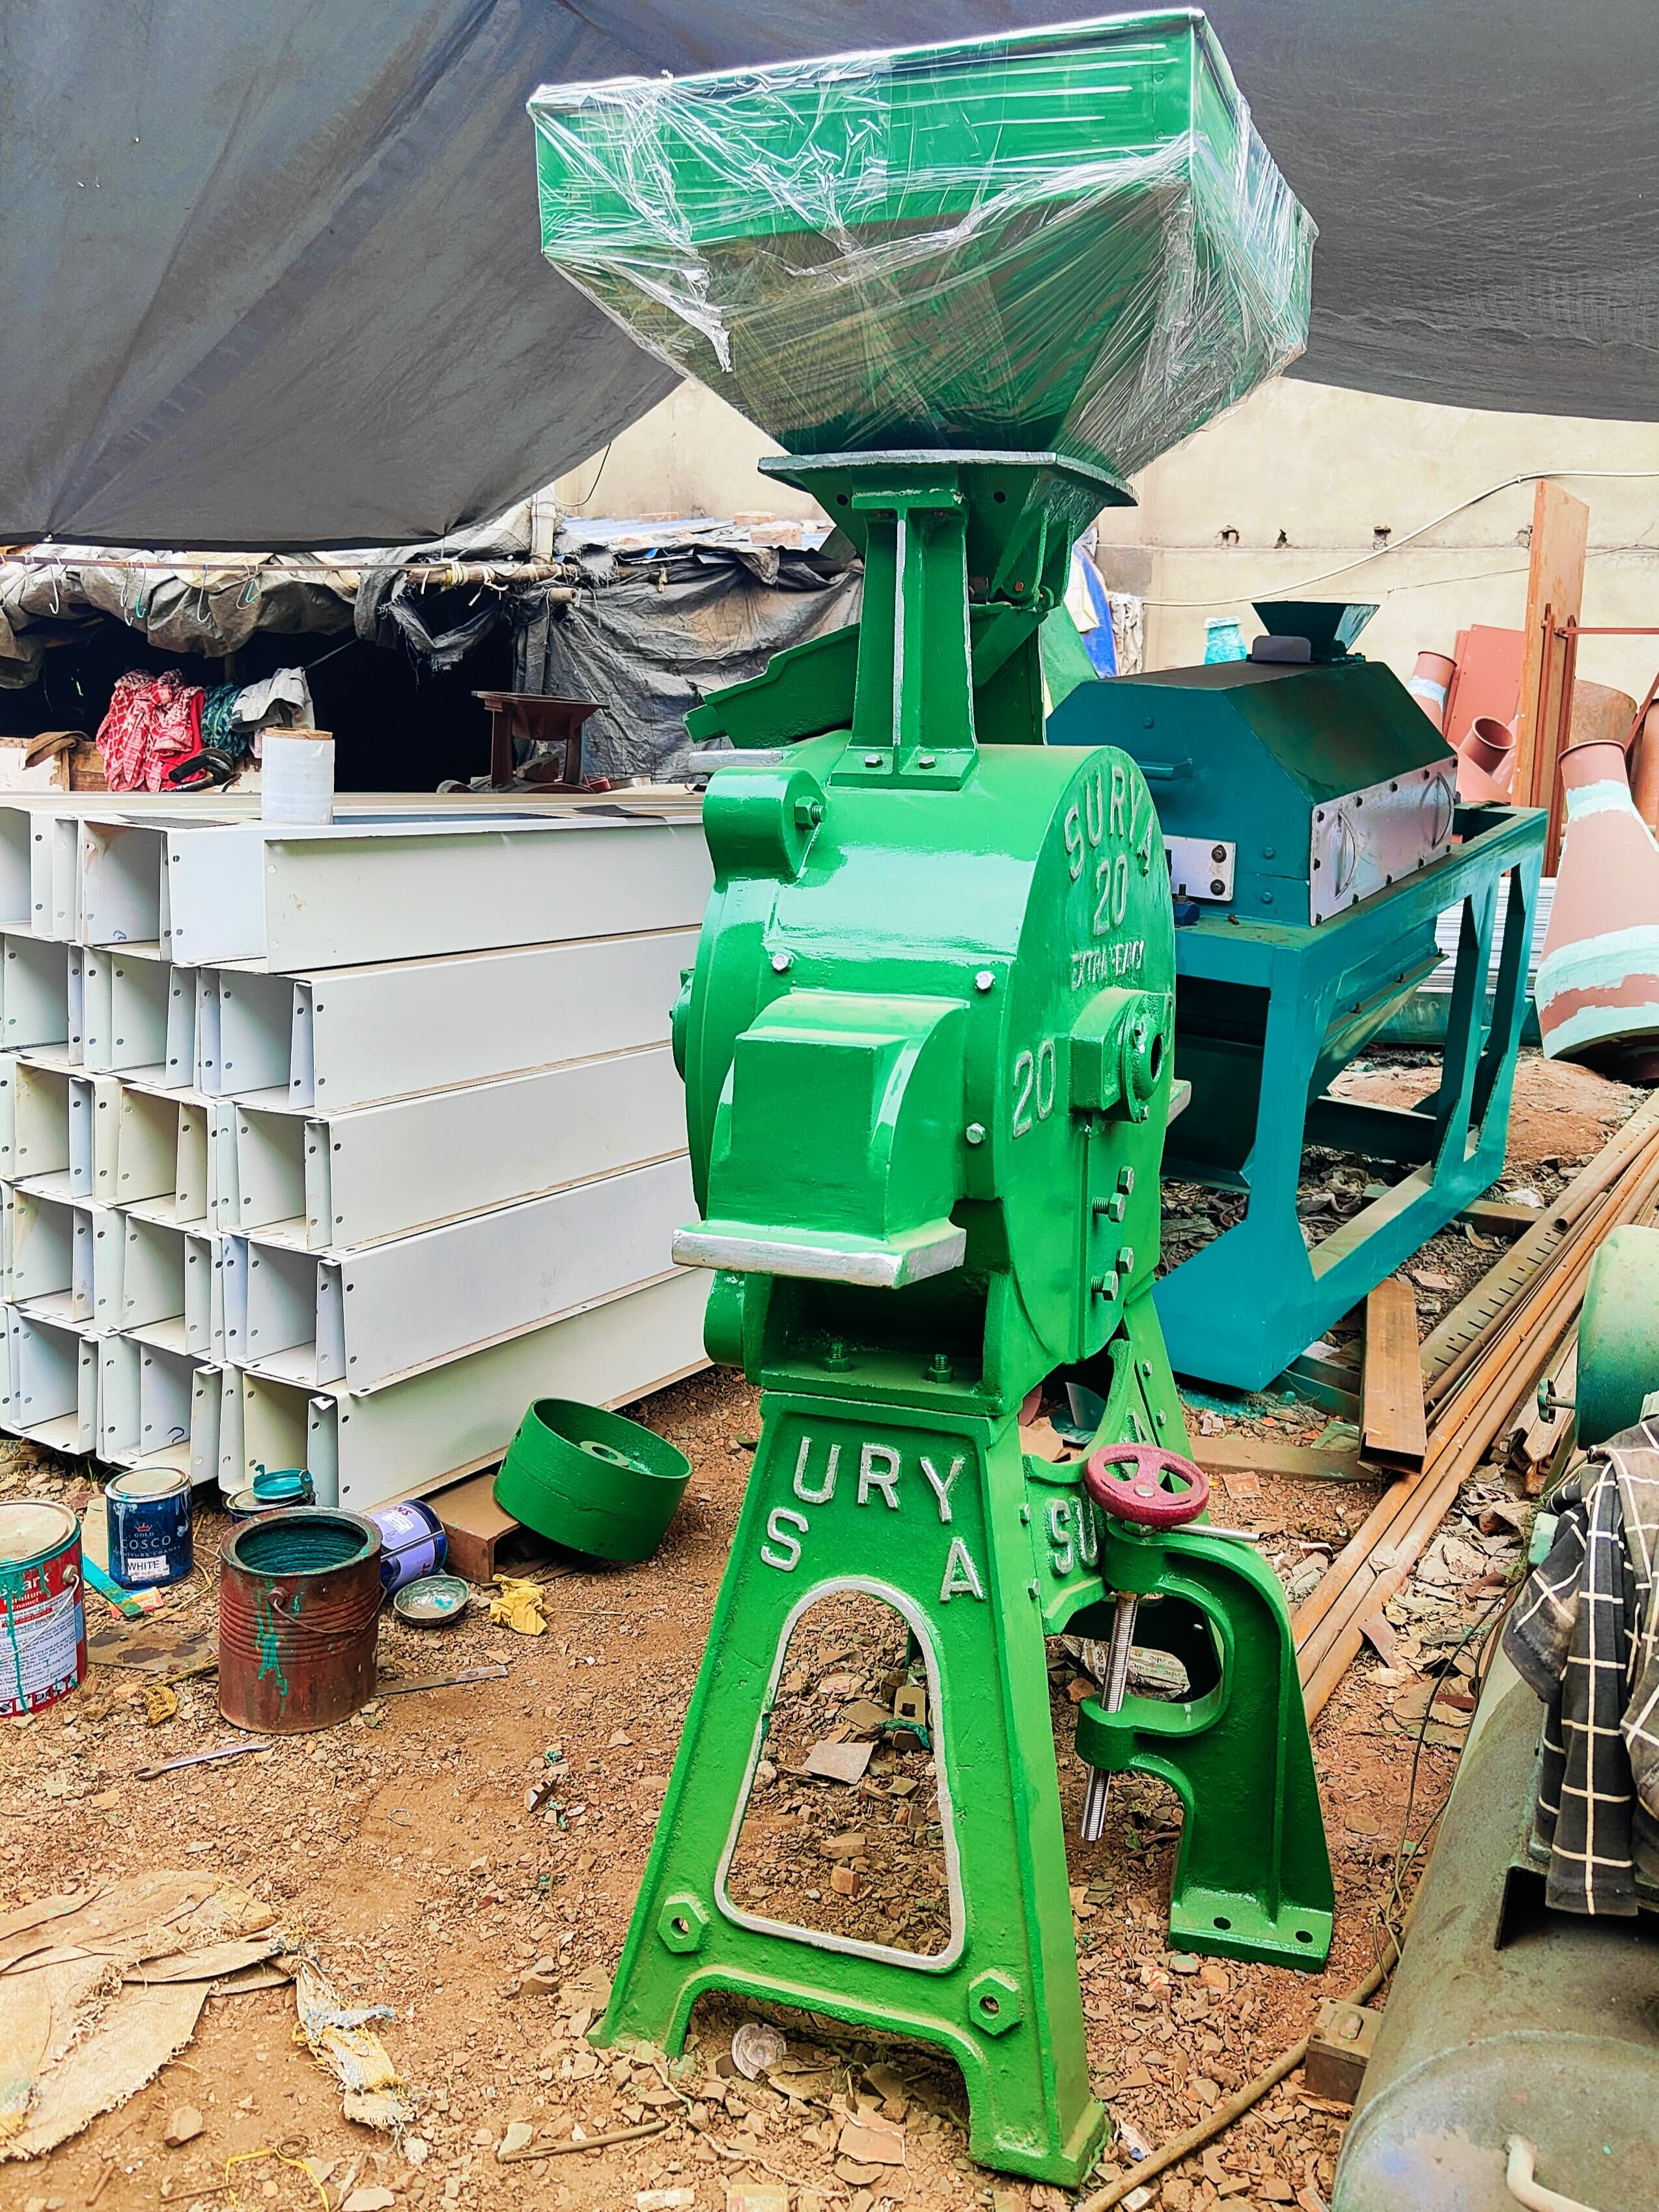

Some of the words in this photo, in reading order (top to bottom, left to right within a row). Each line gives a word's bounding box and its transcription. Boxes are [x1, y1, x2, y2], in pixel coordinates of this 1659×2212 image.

[1064, 765, 1154, 879] SURYA
[1094, 854, 1127, 936] 20
[1013, 1042, 1055, 1139] 20
[127, 1560, 160, 1571] WHITE
